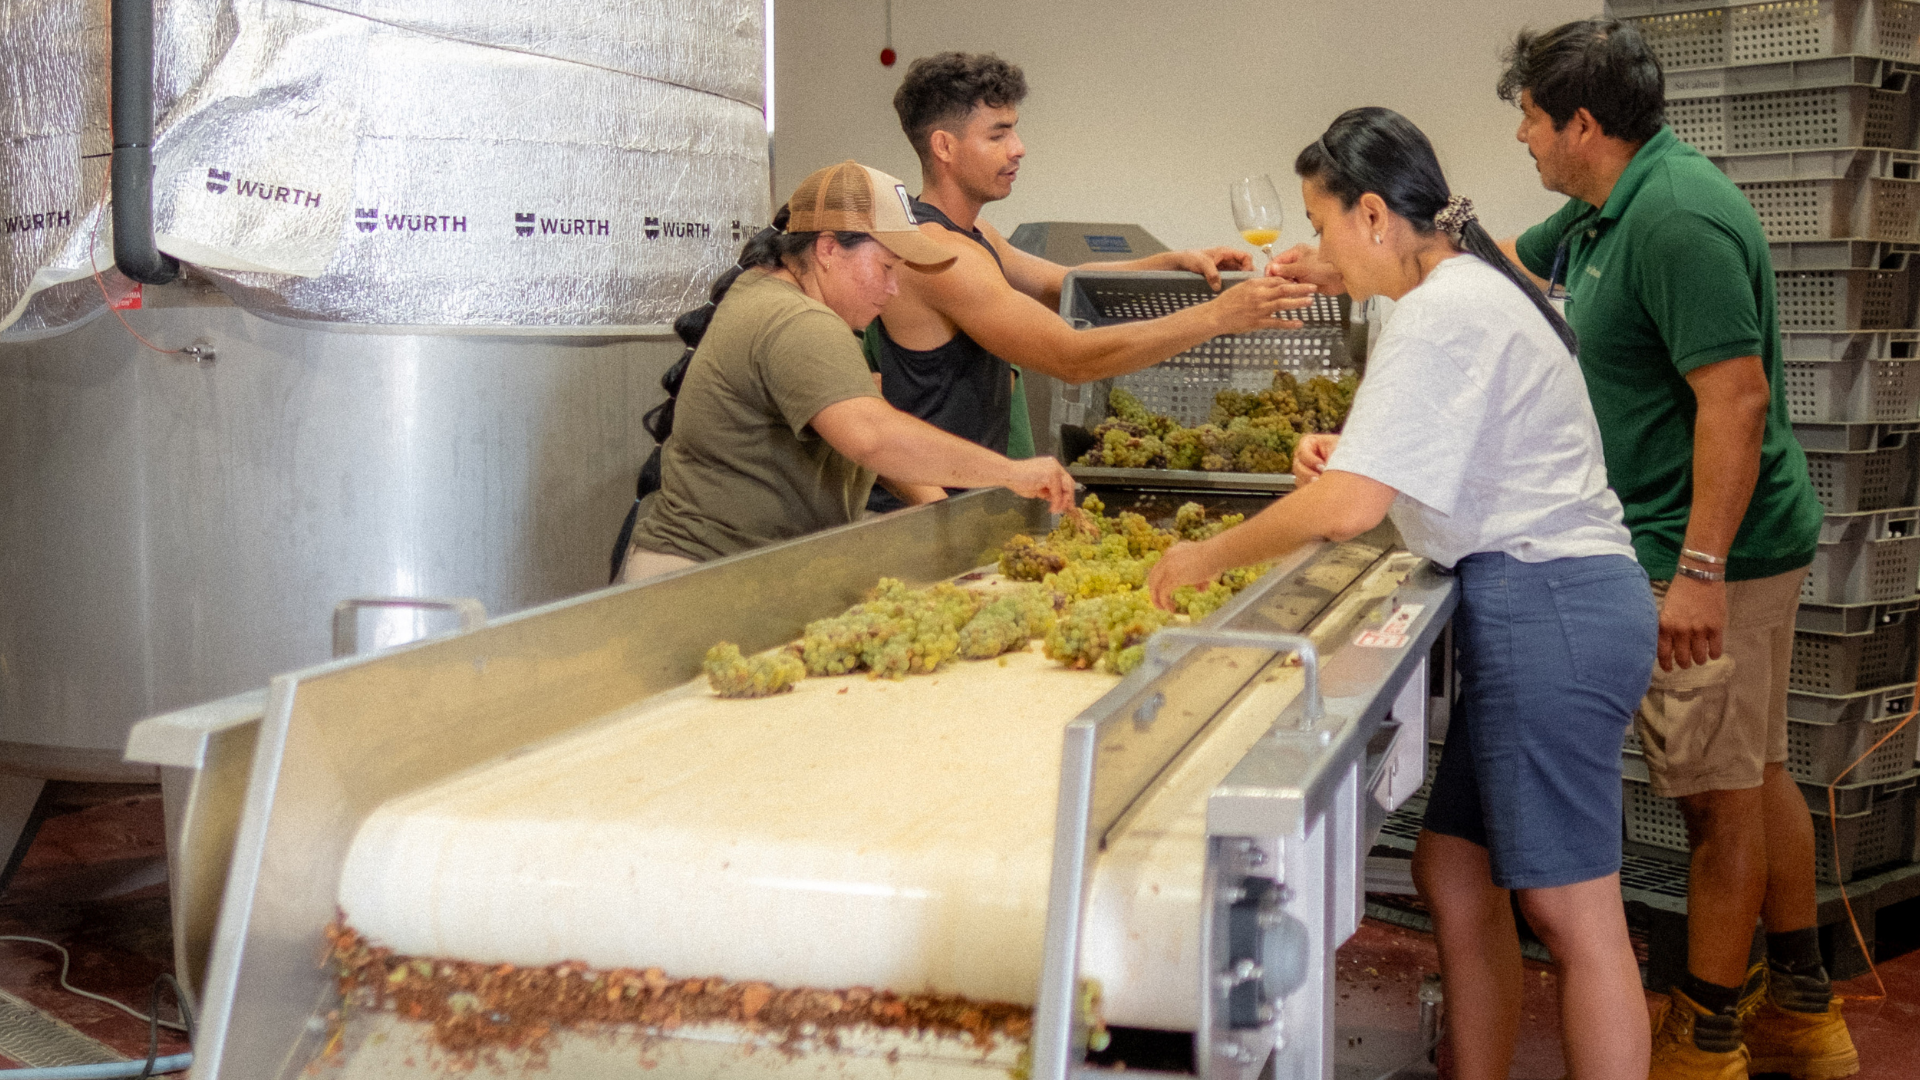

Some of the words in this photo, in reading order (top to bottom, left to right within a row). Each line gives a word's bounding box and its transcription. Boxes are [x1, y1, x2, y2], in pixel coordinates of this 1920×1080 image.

[236, 178, 322, 208] WÜRTH
[4, 210, 70, 234] WÜRTH
[384, 213, 467, 232] WÜRTH
[540, 218, 609, 236] WÜRTH
[662, 221, 710, 238] WÜRTH
[741, 224, 763, 240] WÜR
